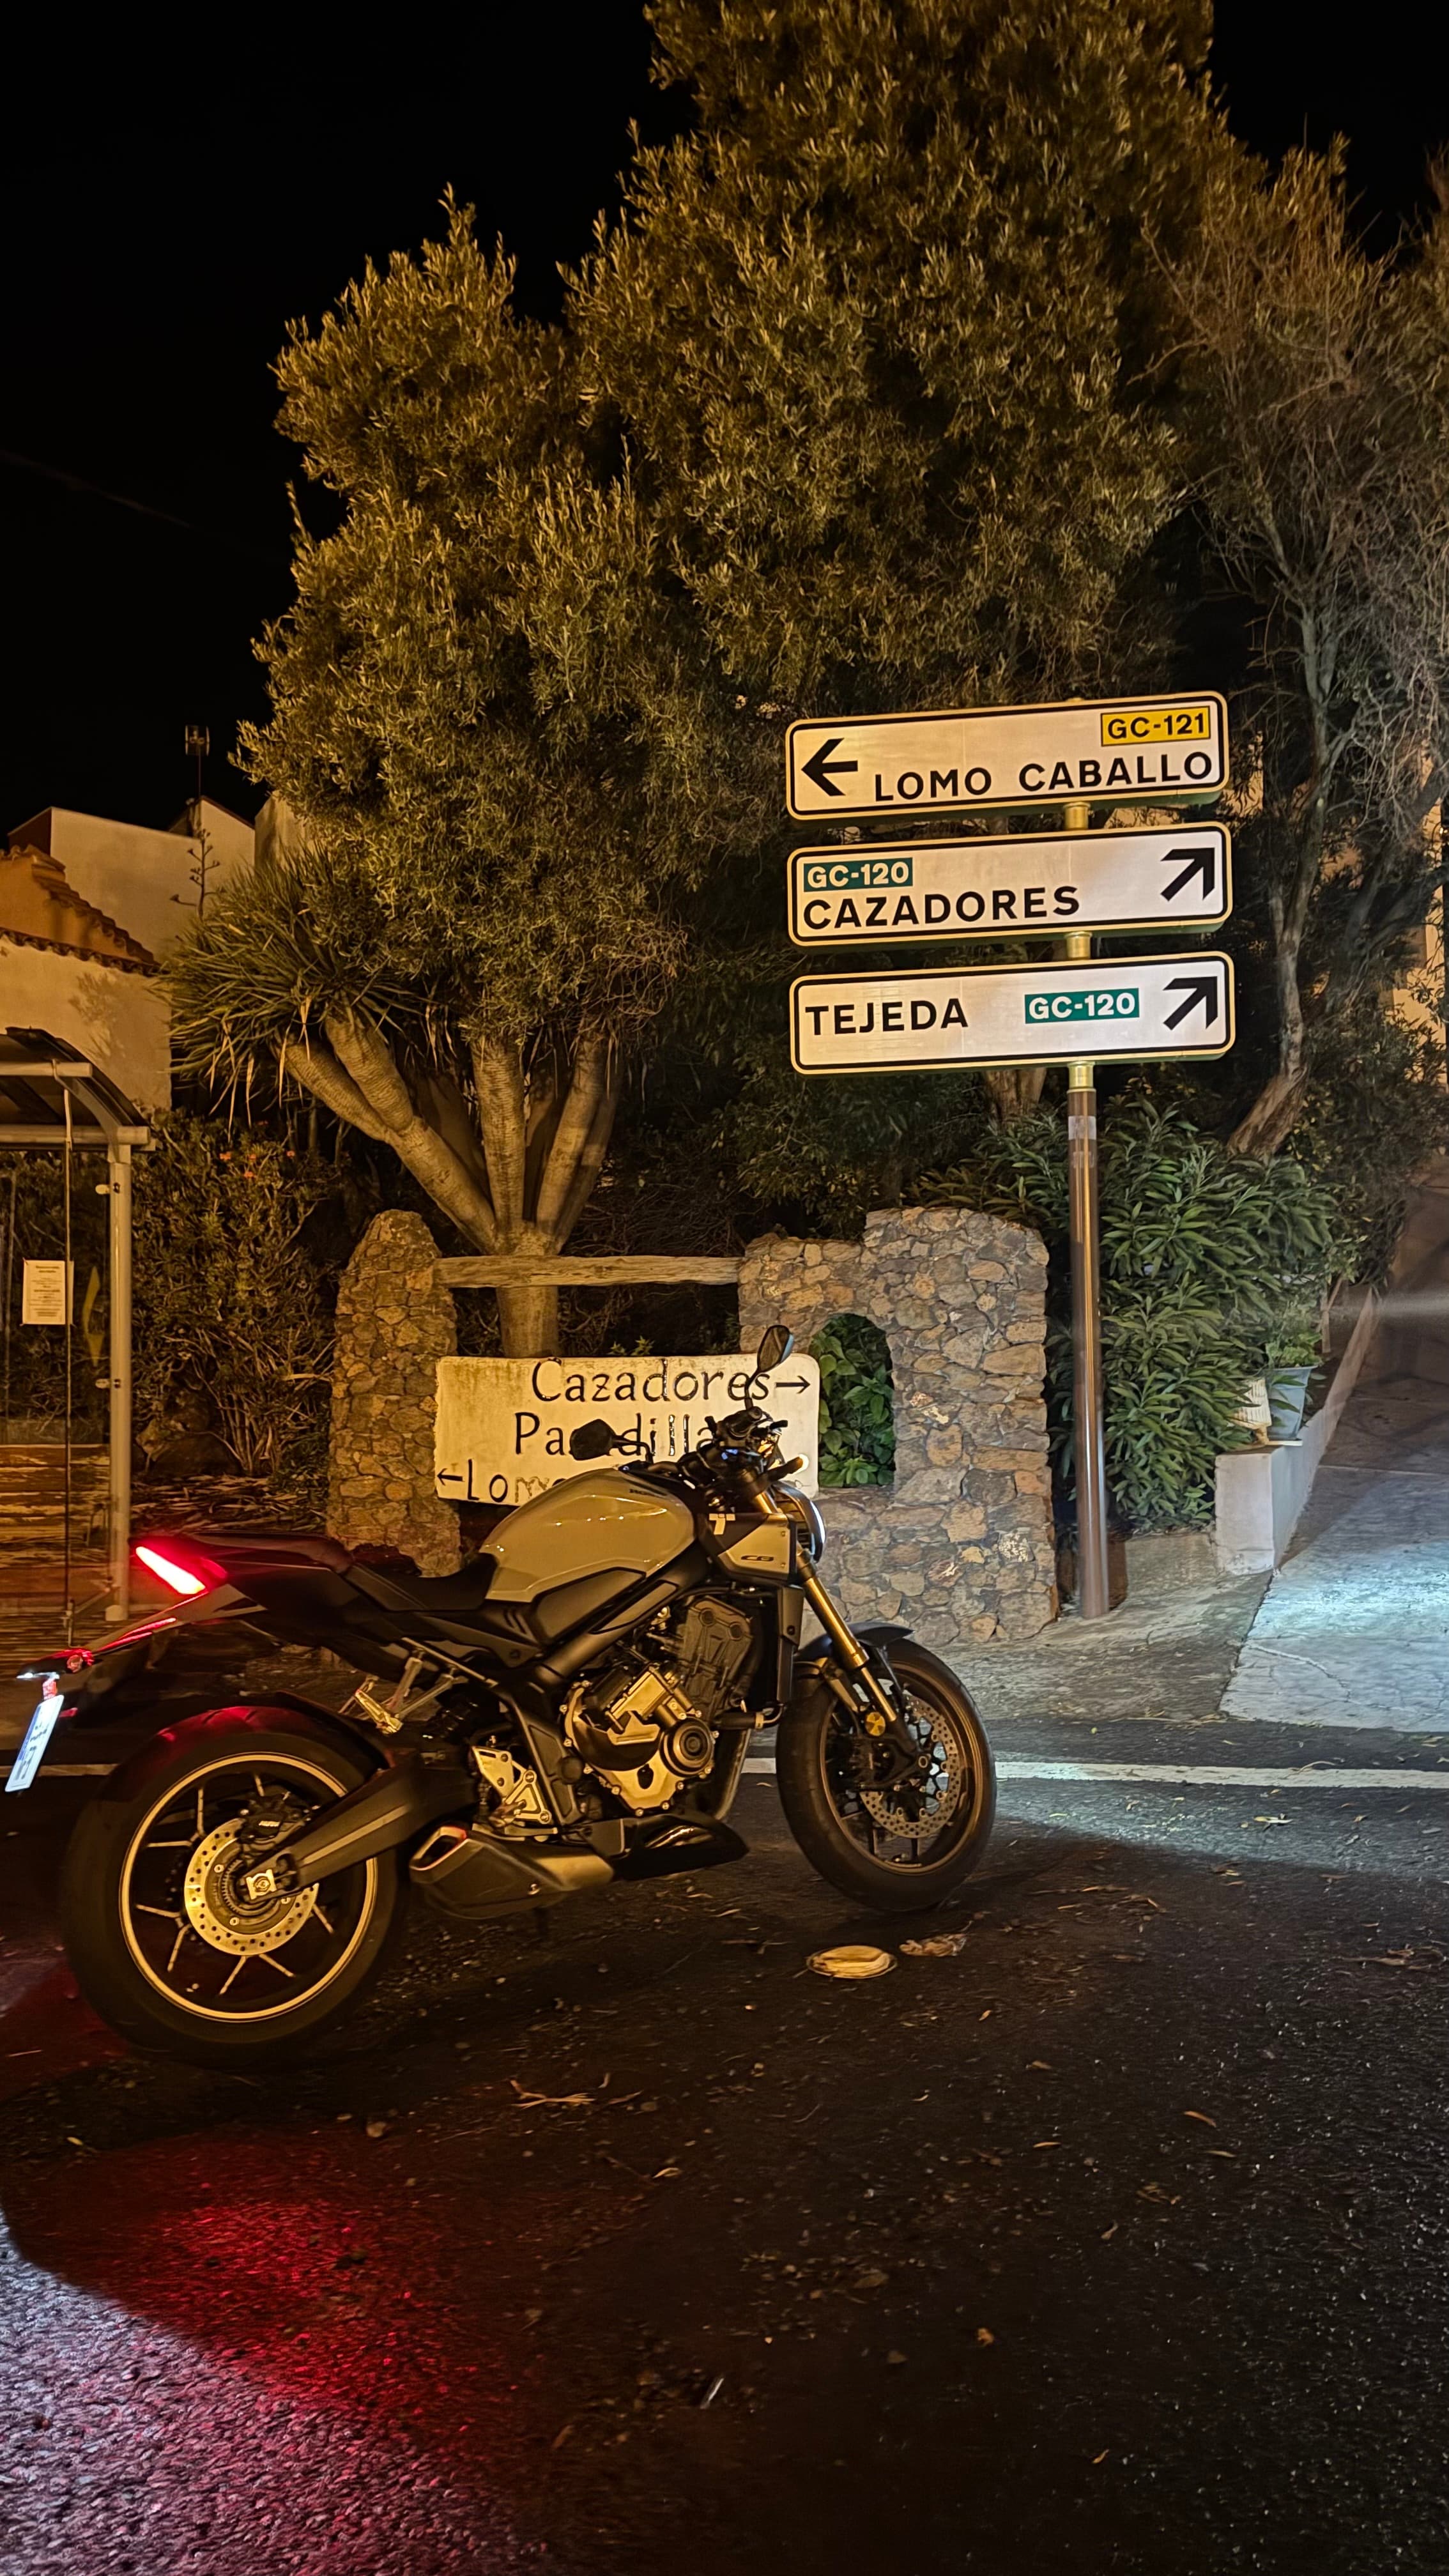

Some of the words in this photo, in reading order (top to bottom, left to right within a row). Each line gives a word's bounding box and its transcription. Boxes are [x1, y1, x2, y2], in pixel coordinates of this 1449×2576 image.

[1107, 713, 1206, 739] GC-121
[875, 767, 992, 802] LOMO
[1018, 751, 1212, 792] CABALLO
[806, 861, 910, 888] GC-120
[803, 885, 1080, 930] CAZADORES
[805, 998, 968, 1036] TEJEDA
[1029, 992, 1136, 1020] GC-120
[532, 1357, 770, 1402] Cazadores
[467, 1459, 567, 1503] Lom
